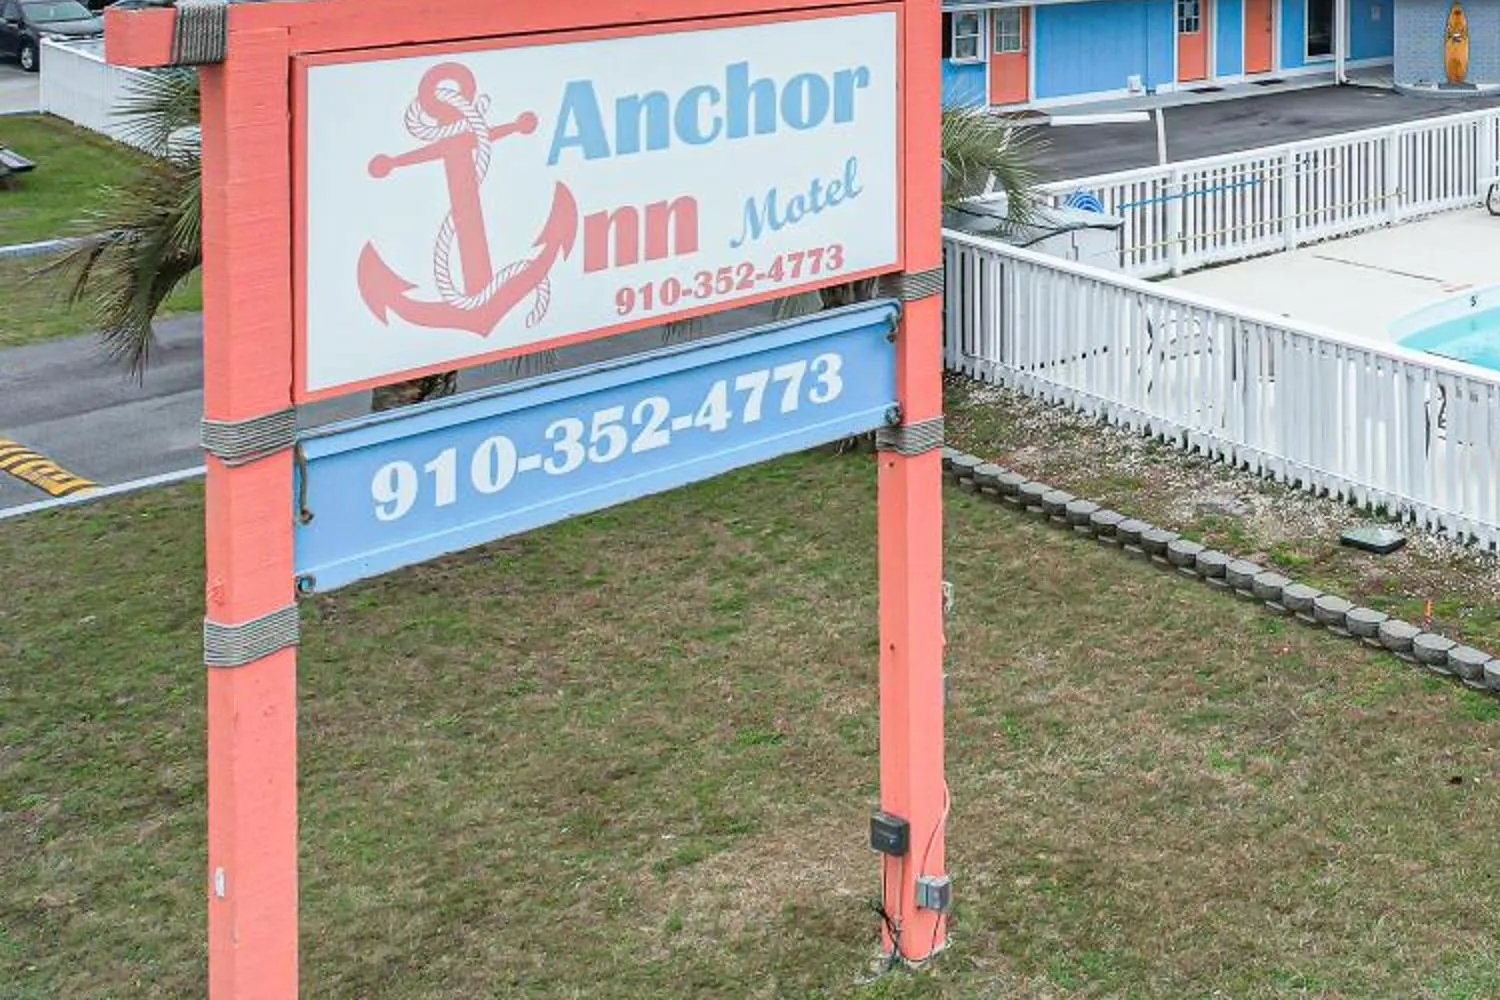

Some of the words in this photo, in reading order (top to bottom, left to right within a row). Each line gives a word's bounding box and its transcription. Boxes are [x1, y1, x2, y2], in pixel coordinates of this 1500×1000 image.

[546, 60, 871, 166] Anchor
[729, 155, 865, 249] Motel
[614, 243, 845, 317] 910-352-4773
[370, 352, 844, 522] 910-352-4773
